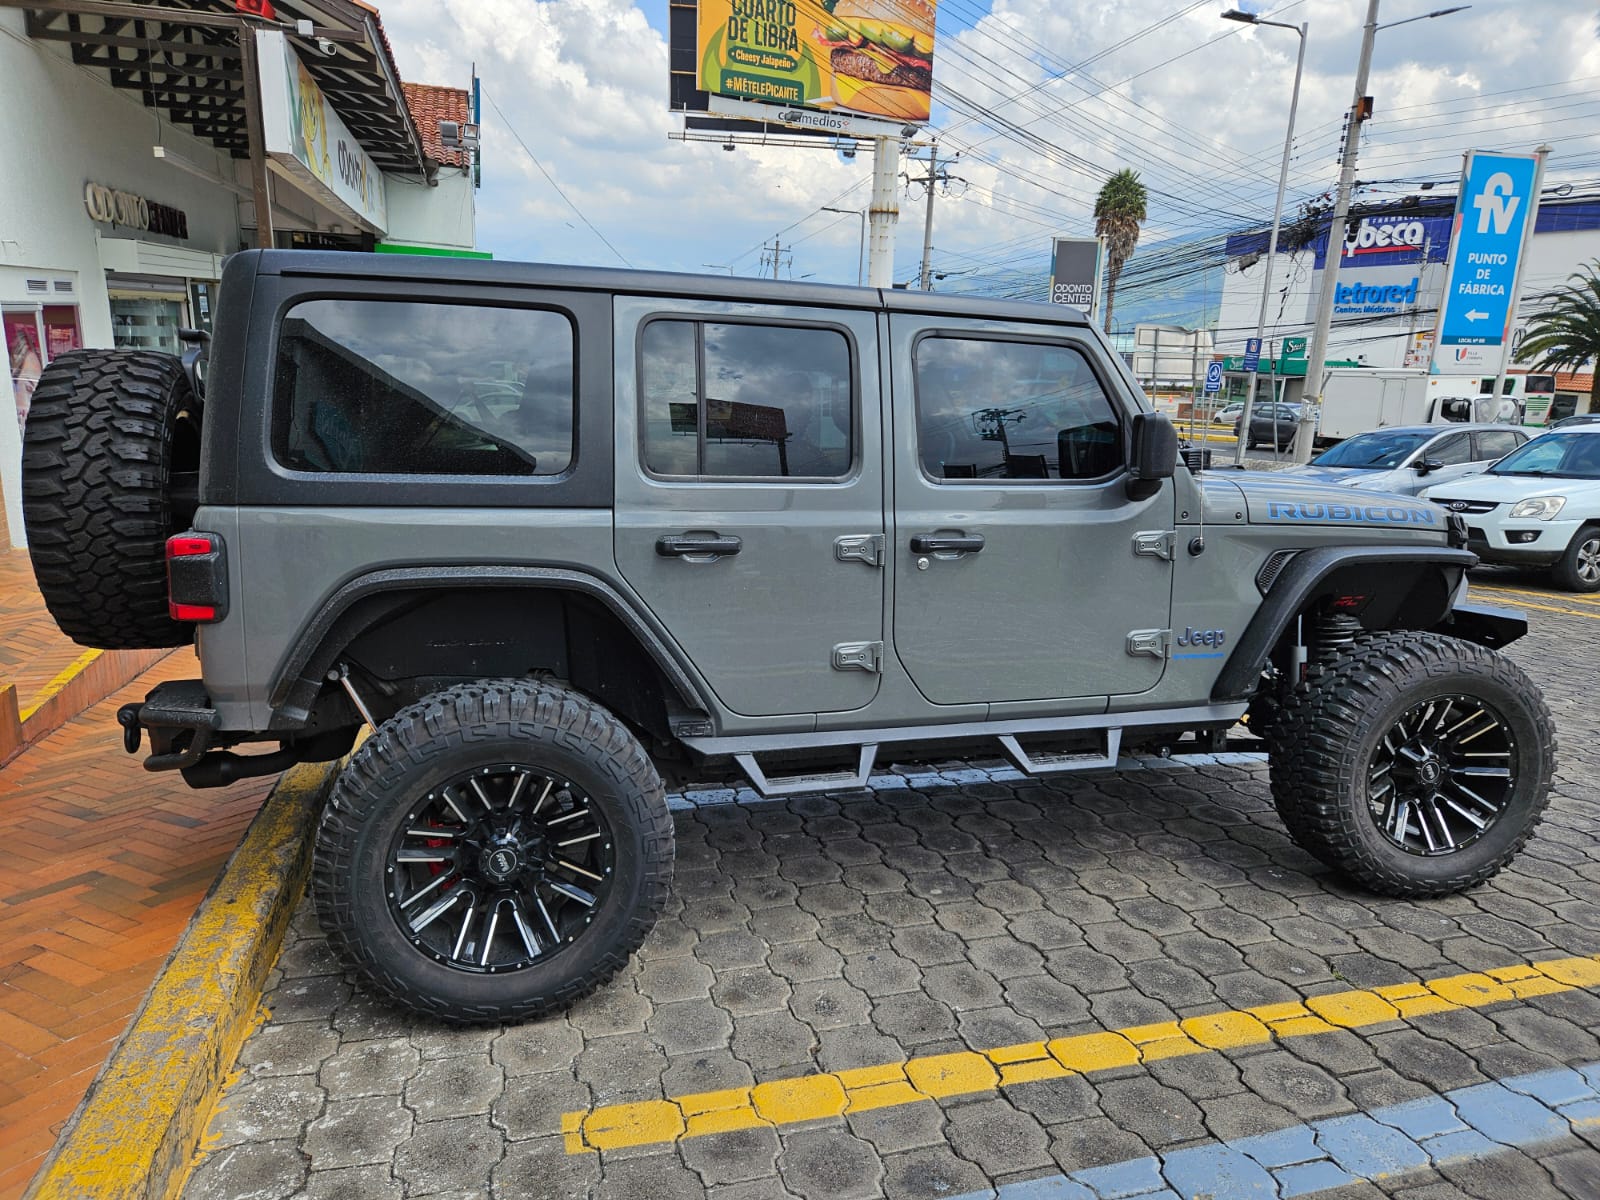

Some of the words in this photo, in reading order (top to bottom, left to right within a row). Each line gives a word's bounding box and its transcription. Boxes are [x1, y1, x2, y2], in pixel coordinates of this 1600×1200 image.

[732, 0, 796, 26] CUARTO
[728, 16, 748, 43] DE
[755, 22, 798, 52] LIBRA
[735, 49, 760, 65] Cheesy
[761, 51, 791, 68] Jalapeño
[1343, 218, 1425, 258] ybeca
[1467, 252, 1508, 265] PUNTO
[1475, 268, 1491, 280] DE
[1054, 283, 1093, 293] ODONTO
[1334, 277, 1419, 305] etrored
[1458, 280, 1505, 296] FÁBRICA
[1053, 293, 1092, 304] CENTER
[1334, 305, 1362, 313] Centros
[1267, 502, 1436, 525] RUBICON
[1178, 626, 1225, 649] Jeep
